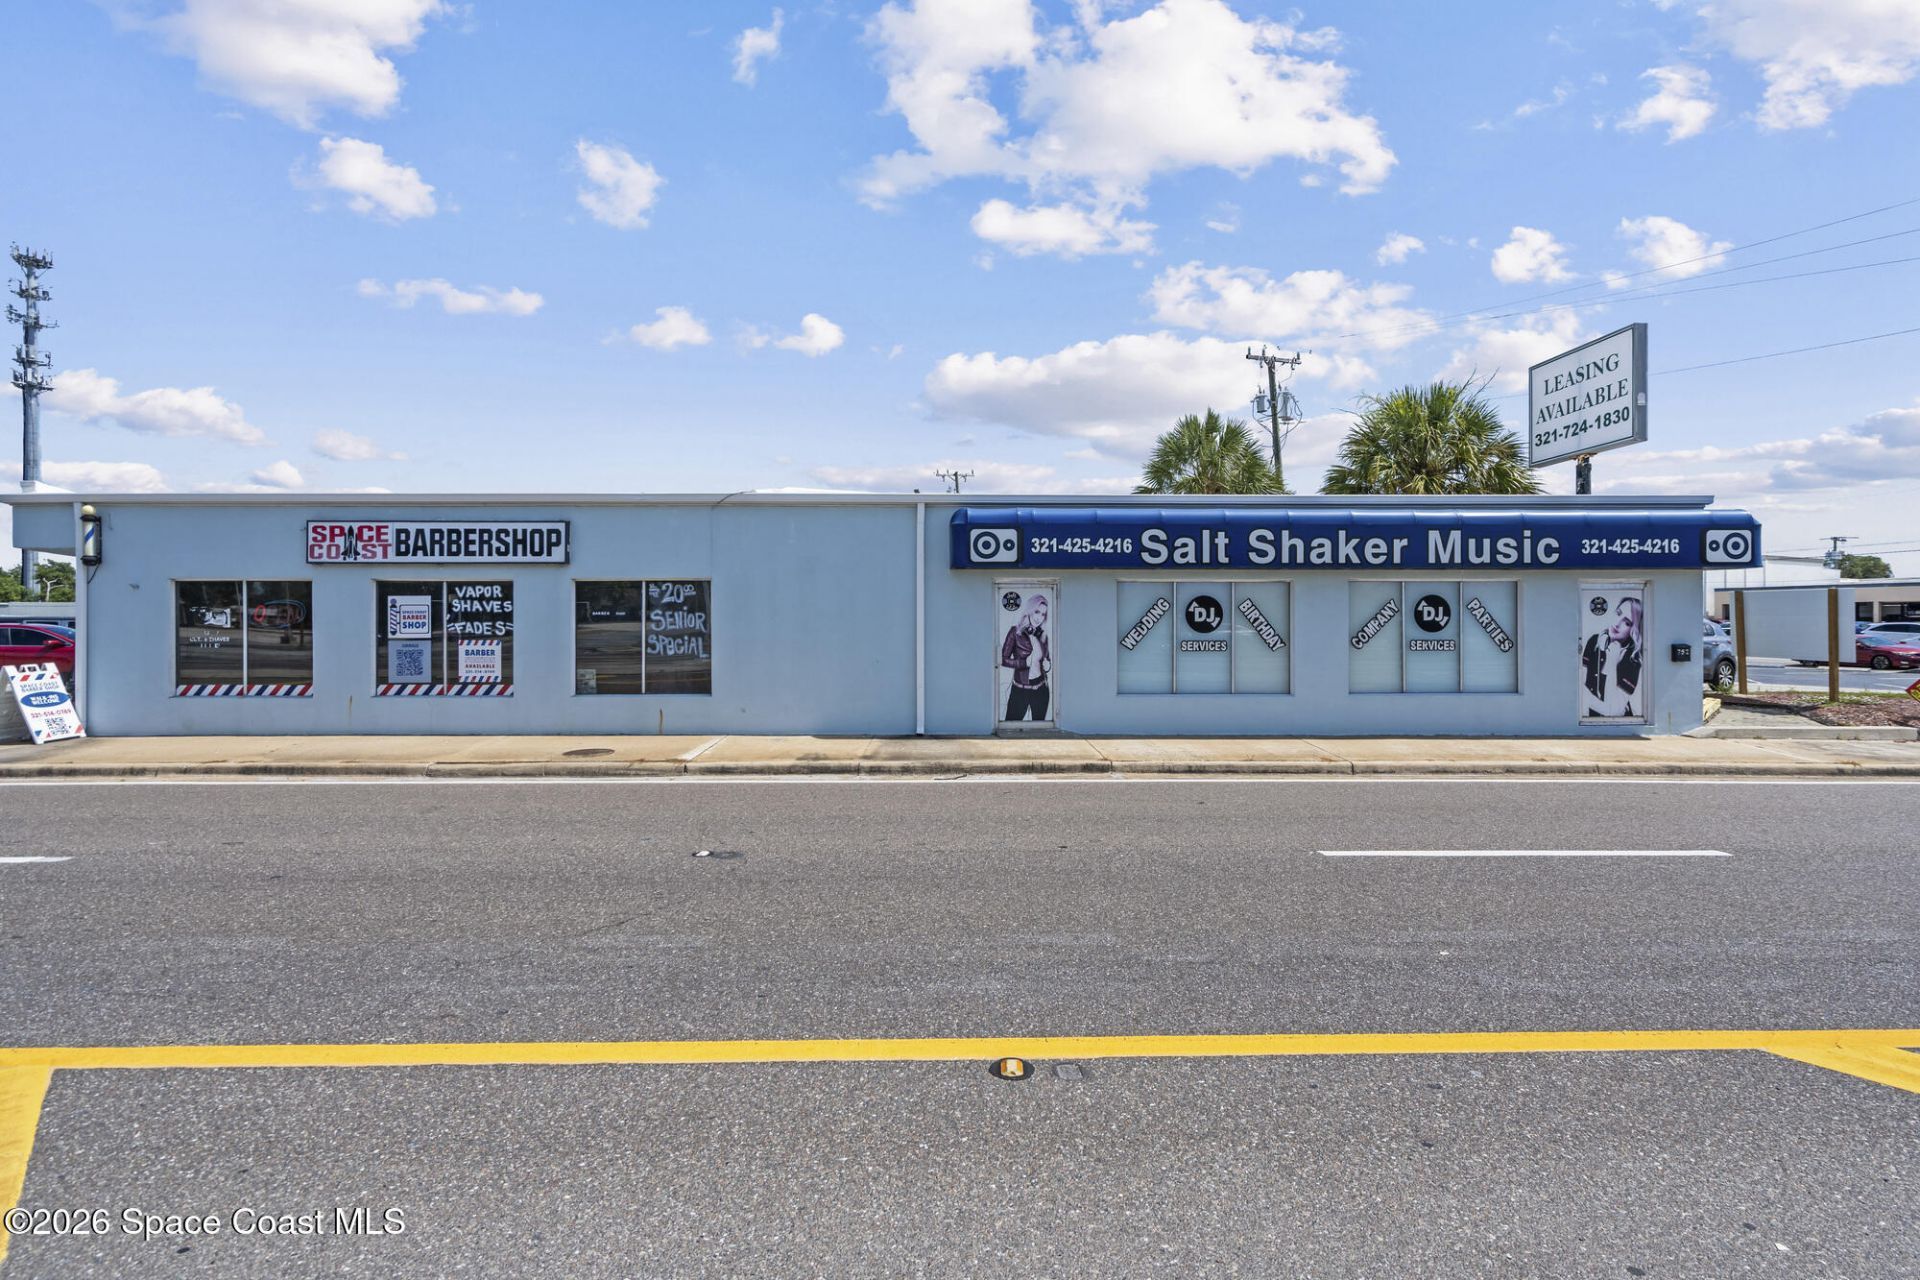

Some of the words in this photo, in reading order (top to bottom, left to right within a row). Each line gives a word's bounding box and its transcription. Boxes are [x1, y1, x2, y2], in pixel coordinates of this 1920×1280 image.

[1544, 353, 1619, 395] LEASING
[1536, 378, 1629, 425] AVAILABLE
[1535, 406, 1630, 447] 321-724-1830
[395, 528, 562, 557] BARBERSHOP
[1031, 538, 1133, 553] 321-425-4216
[1140, 528, 1229, 565] Salt
[1248, 529, 1408, 565] Shaker
[1427, 529, 1560, 565] Music
[1581, 538, 1680, 554] 321-425-4216
[456, 585, 502, 598] VAPOR
[452, 599, 512, 613] SHAVES
[1194, 607, 1216, 622] DJ
[1422, 606, 1444, 622] DJ
[402, 621, 427, 629] SHOP
[455, 621, 506, 636] FADES
[650, 606, 706, 633] SENIOR
[1120, 597, 1171, 650] WEDDING
[1238, 598, 1286, 652] BIRTHDAY
[1350, 598, 1400, 650] COMPANY
[1466, 598, 1513, 652] PARTIES
[464, 649, 496, 657] BARBER
[647, 634, 709, 658] SPECIAL
[1181, 640, 1227, 651] SERVICES
[1410, 640, 1455, 651] SERVICES
